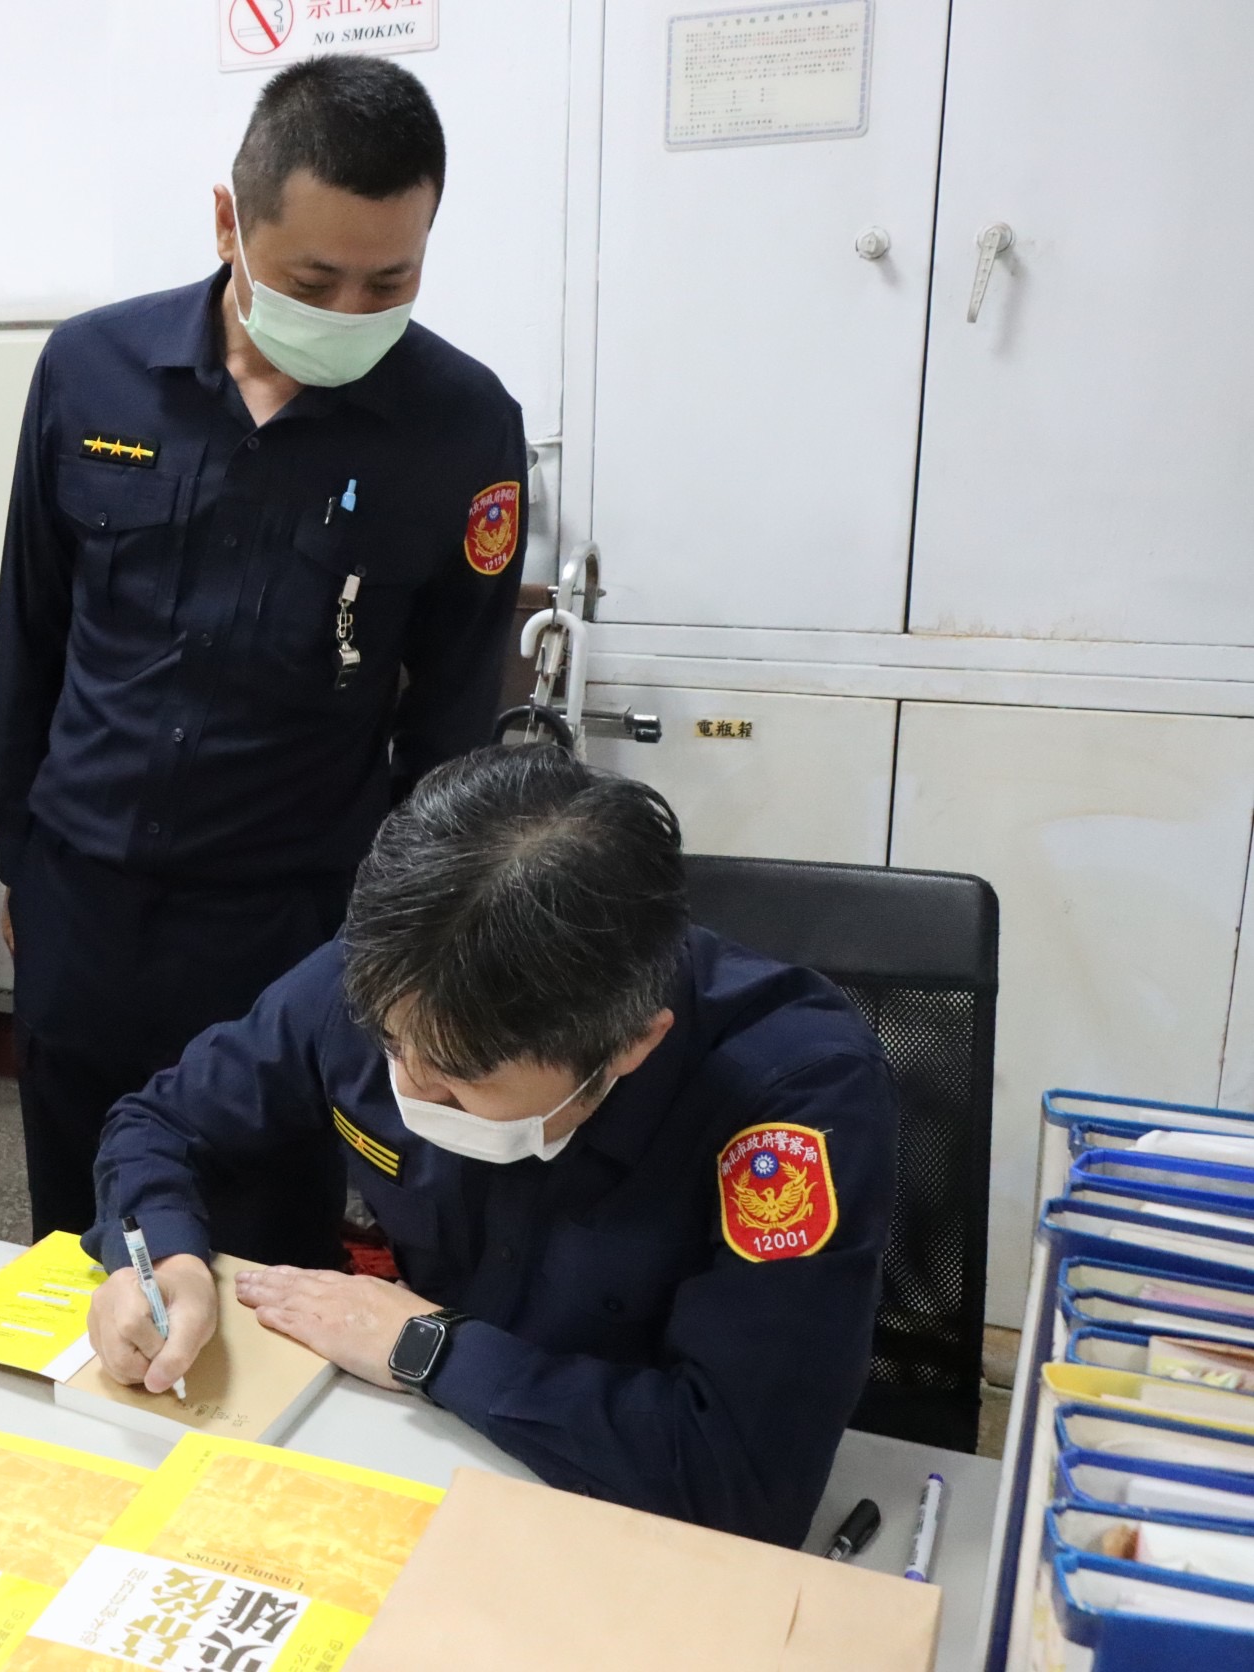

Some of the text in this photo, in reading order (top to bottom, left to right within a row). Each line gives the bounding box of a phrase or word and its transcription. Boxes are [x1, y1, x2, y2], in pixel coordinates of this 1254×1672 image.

[307, 0, 422, 19] 禁止
[313, 21, 415, 45] NO SMOKING
[721, 1131, 819, 1177] 新北市政府警察局
[753, 1229, 808, 1252] 12001
[185, 1551, 306, 1591] Unsung Heroes
